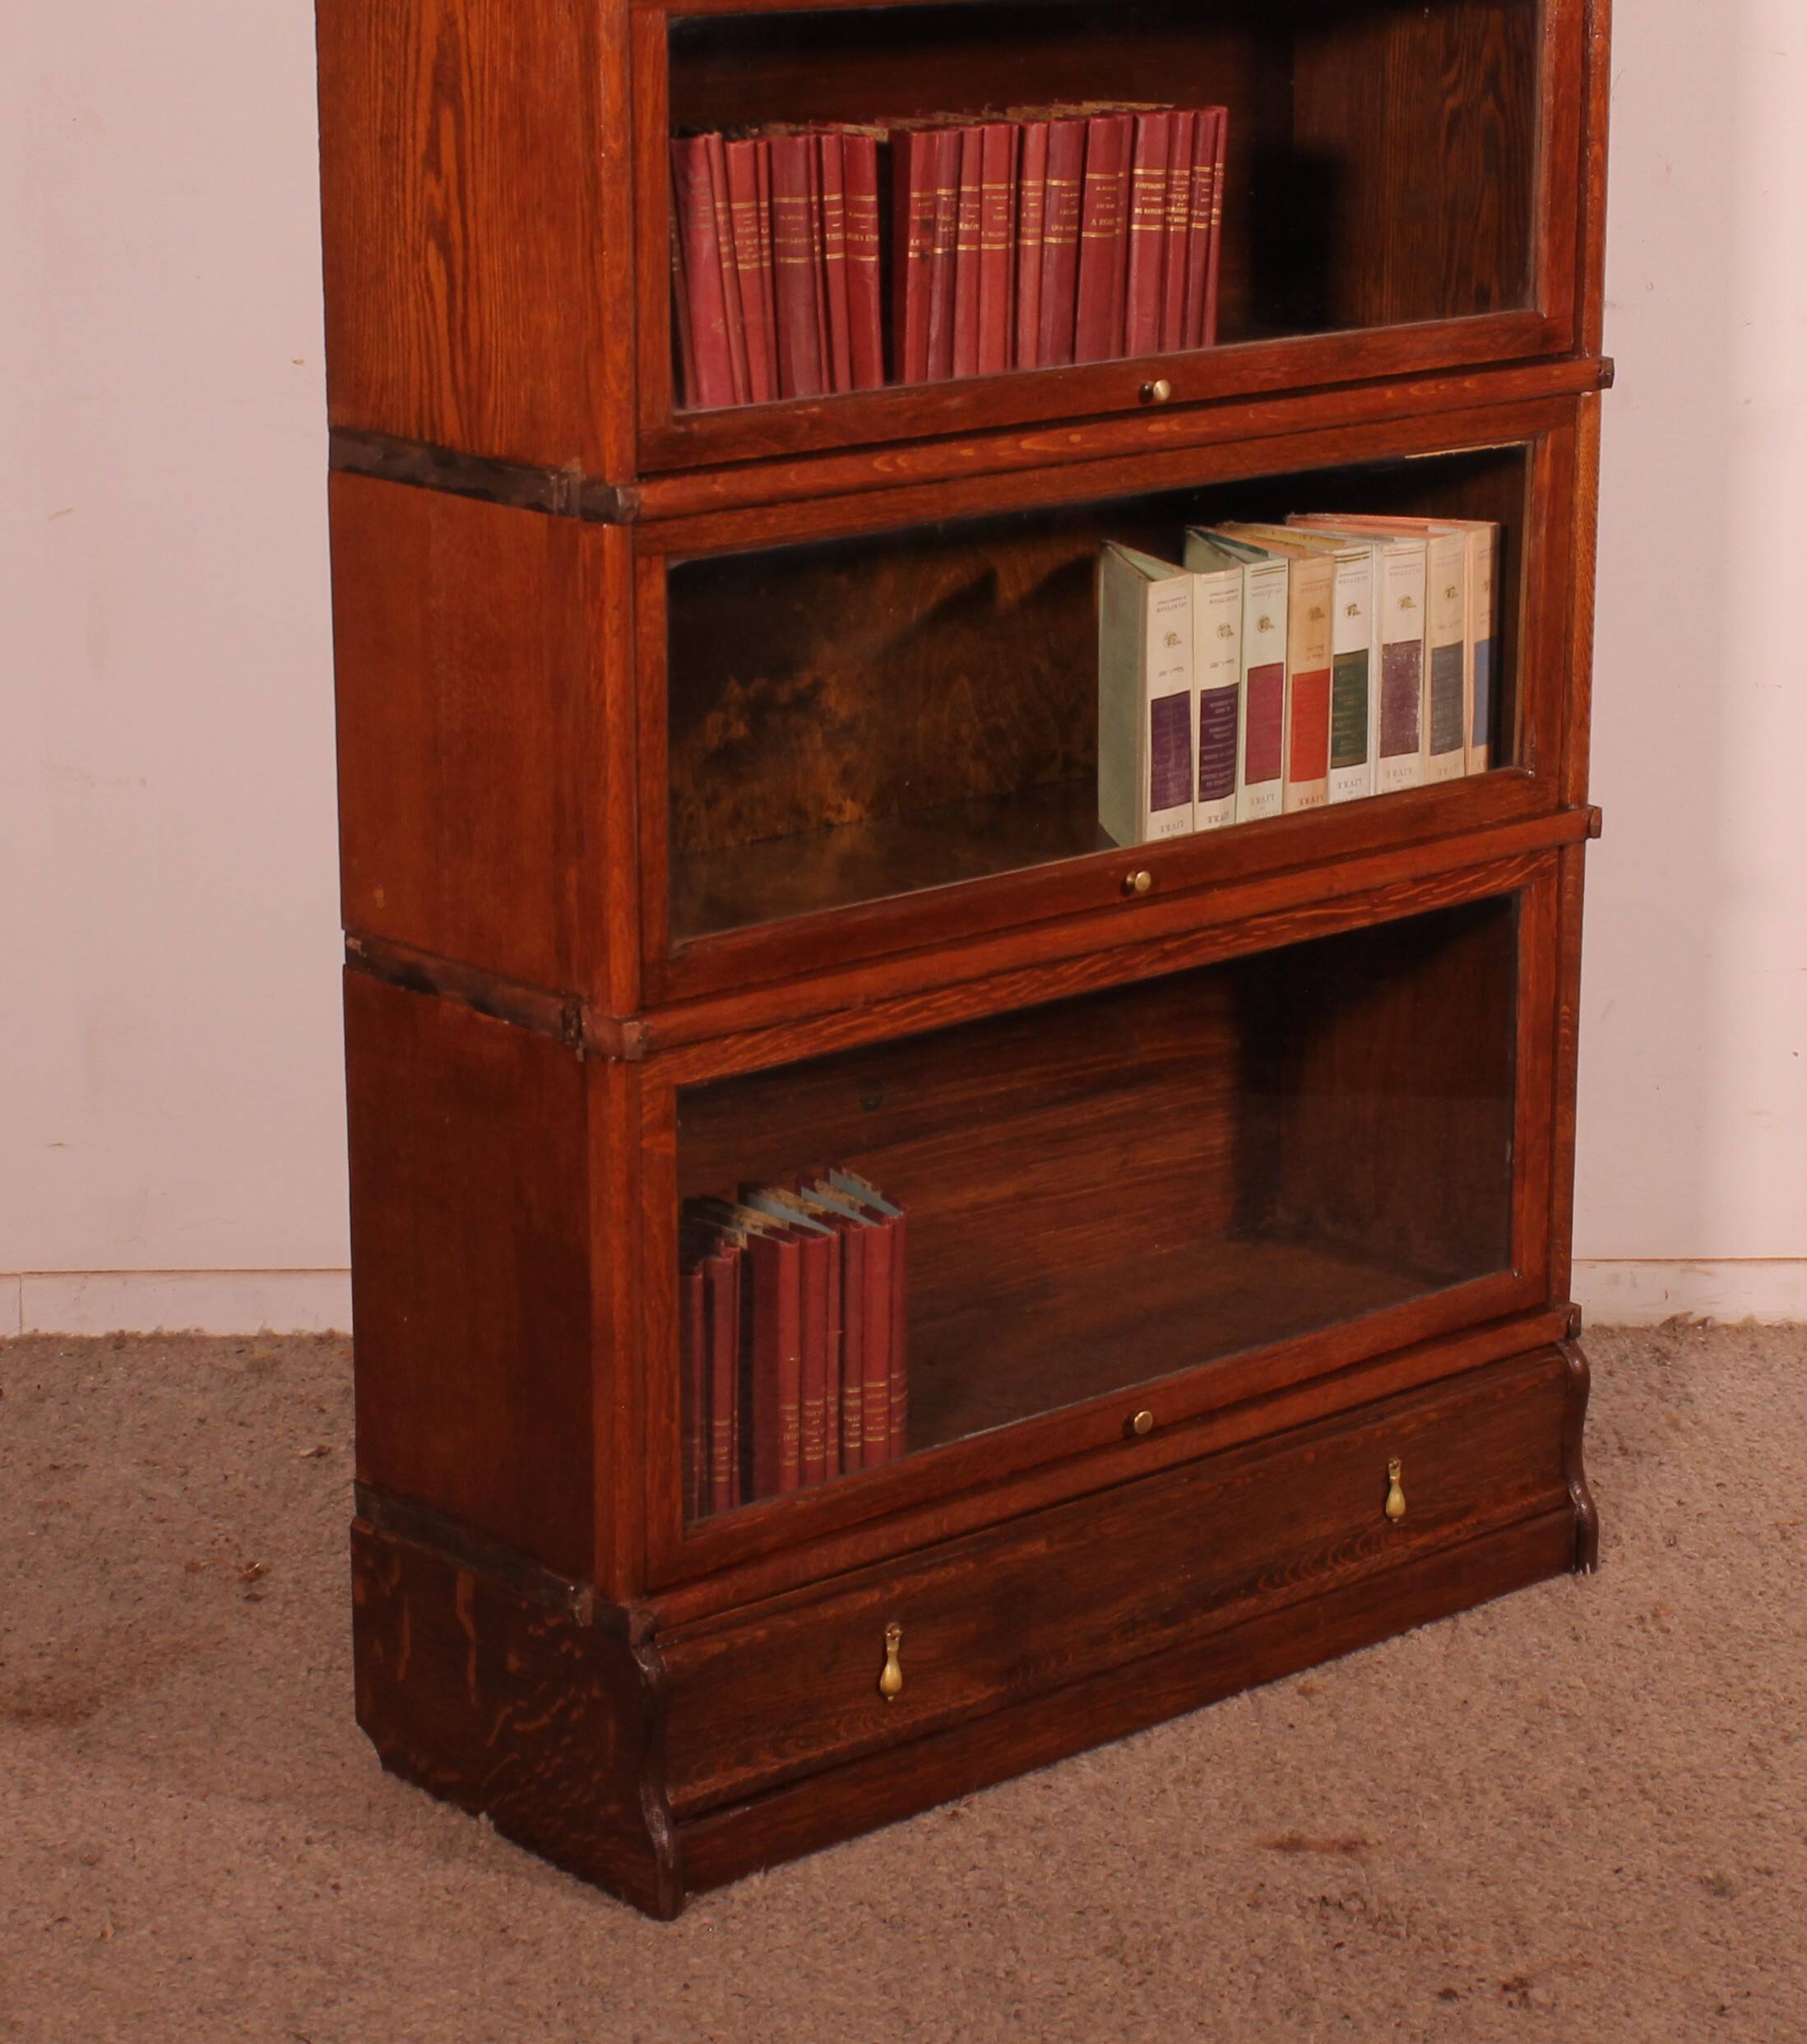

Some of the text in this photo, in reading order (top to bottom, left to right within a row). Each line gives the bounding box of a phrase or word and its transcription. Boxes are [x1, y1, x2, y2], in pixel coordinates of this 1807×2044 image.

[1337, 776, 1362, 790] LIVRE
[1249, 793, 1275, 805] LIVRE
[1159, 819, 1184, 833] LIVRE
